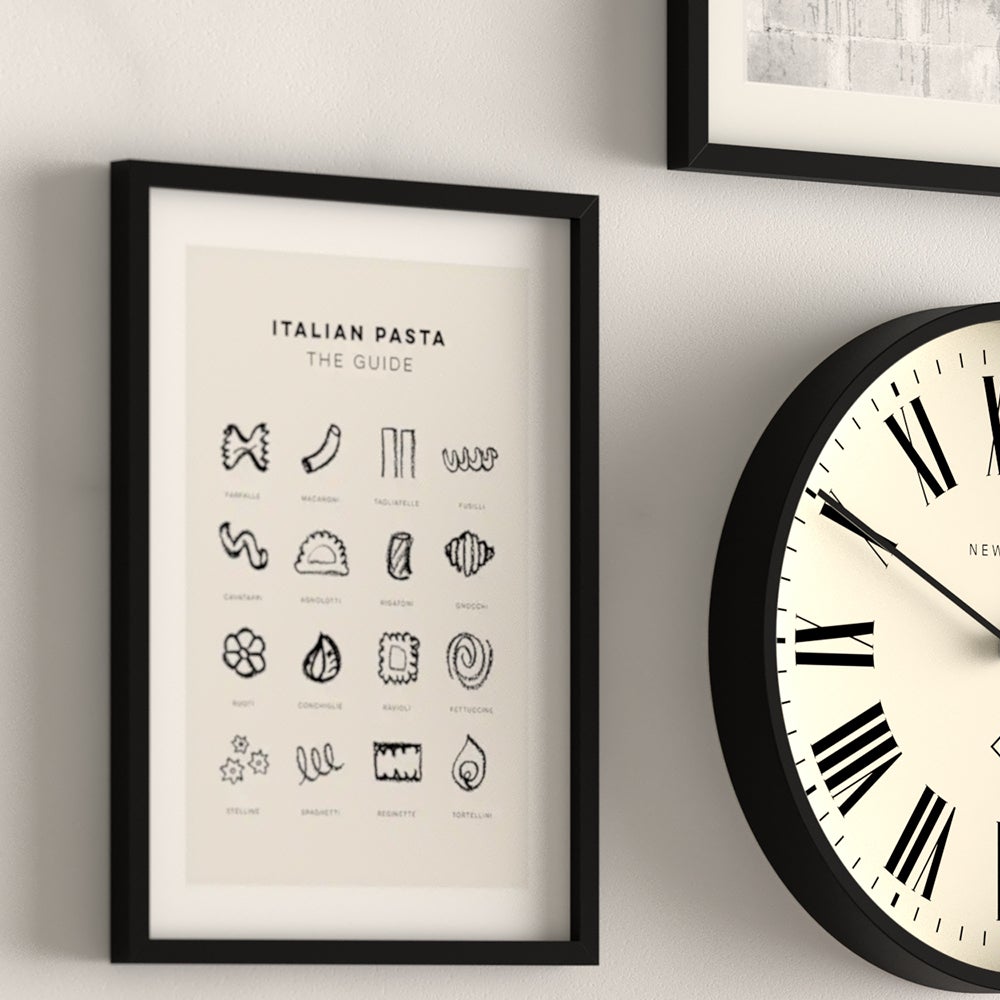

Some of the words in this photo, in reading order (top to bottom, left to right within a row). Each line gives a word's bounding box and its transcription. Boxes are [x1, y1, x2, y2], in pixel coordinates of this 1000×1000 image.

[272, 319, 363, 341] ITALIAN
[375, 326, 446, 347] PASTA
[306, 351, 344, 369] THE
[352, 354, 414, 373] GUIDE
[883, 396, 958, 507] XI
[300, 495, 340, 503] MACARONI
[374, 498, 420, 508] TAGLIATELLE
[457, 502, 487, 511] FUSILLI
[379, 599, 415, 608] RIGATONI
[455, 602, 489, 611] GNOCCHI
[795, 614, 875, 668] IX
[297, 700, 343, 711] CONCHIGLIE
[382, 704, 412, 713] RAVIOLI
[300, 808, 341, 817] SPAGHETTI
[452, 811, 493, 820] TORTELLINI
